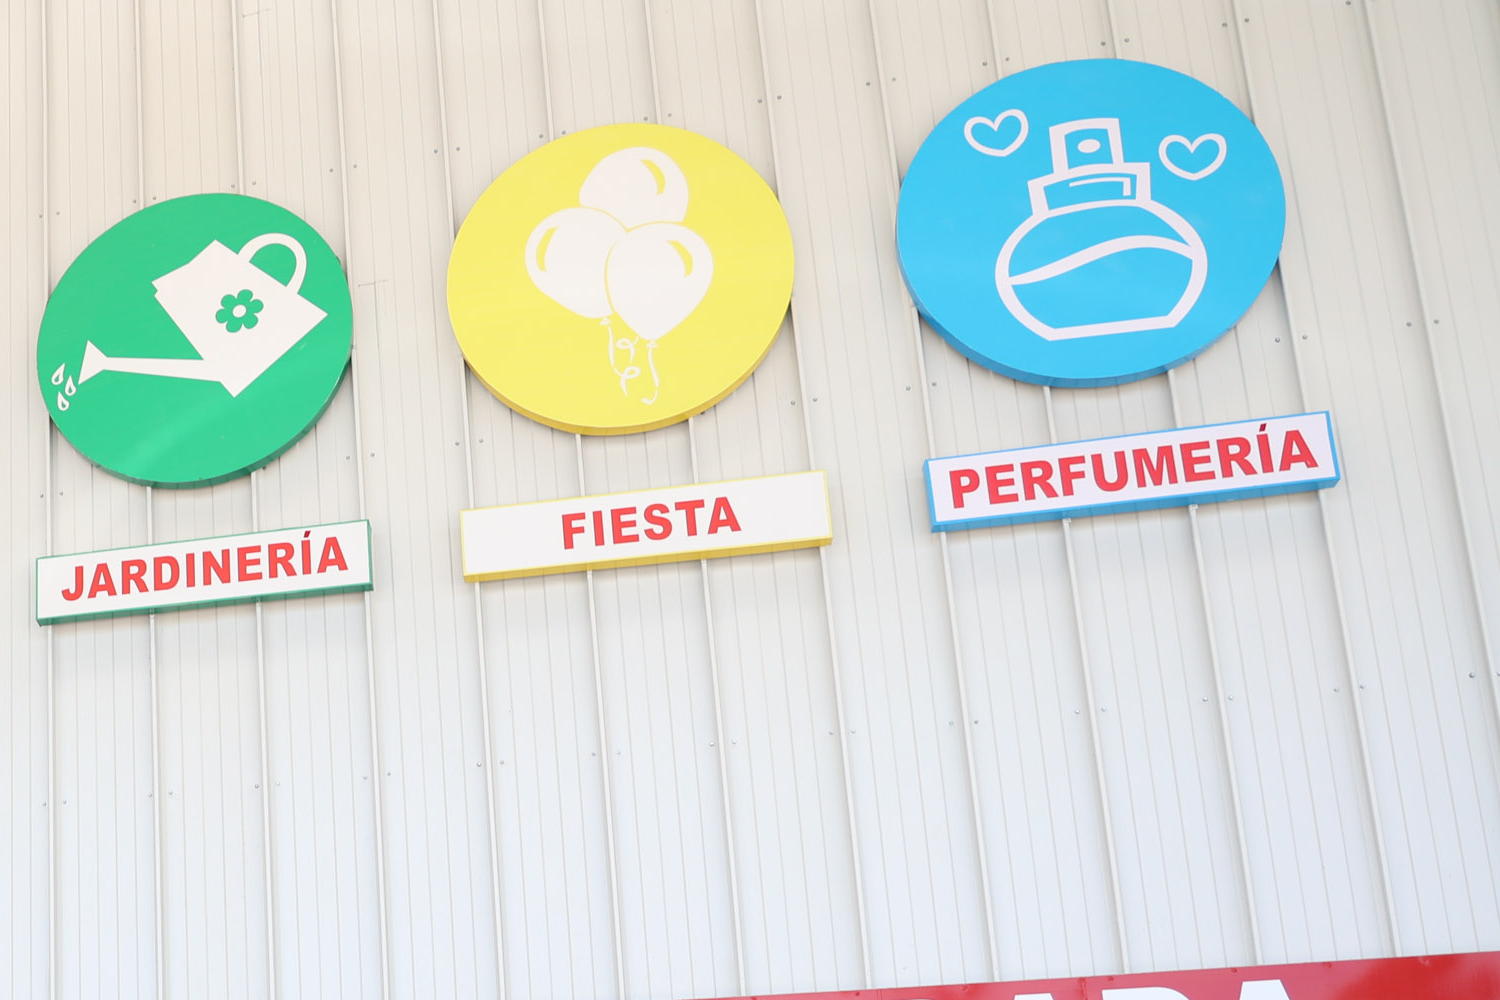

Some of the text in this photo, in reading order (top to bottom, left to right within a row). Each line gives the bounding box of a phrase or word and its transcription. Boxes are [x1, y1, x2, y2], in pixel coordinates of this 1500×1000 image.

[951, 424, 1315, 507] PERFUMERÍA
[563, 498, 739, 548] FIESTA
[63, 533, 346, 599] JARDINERÍA
